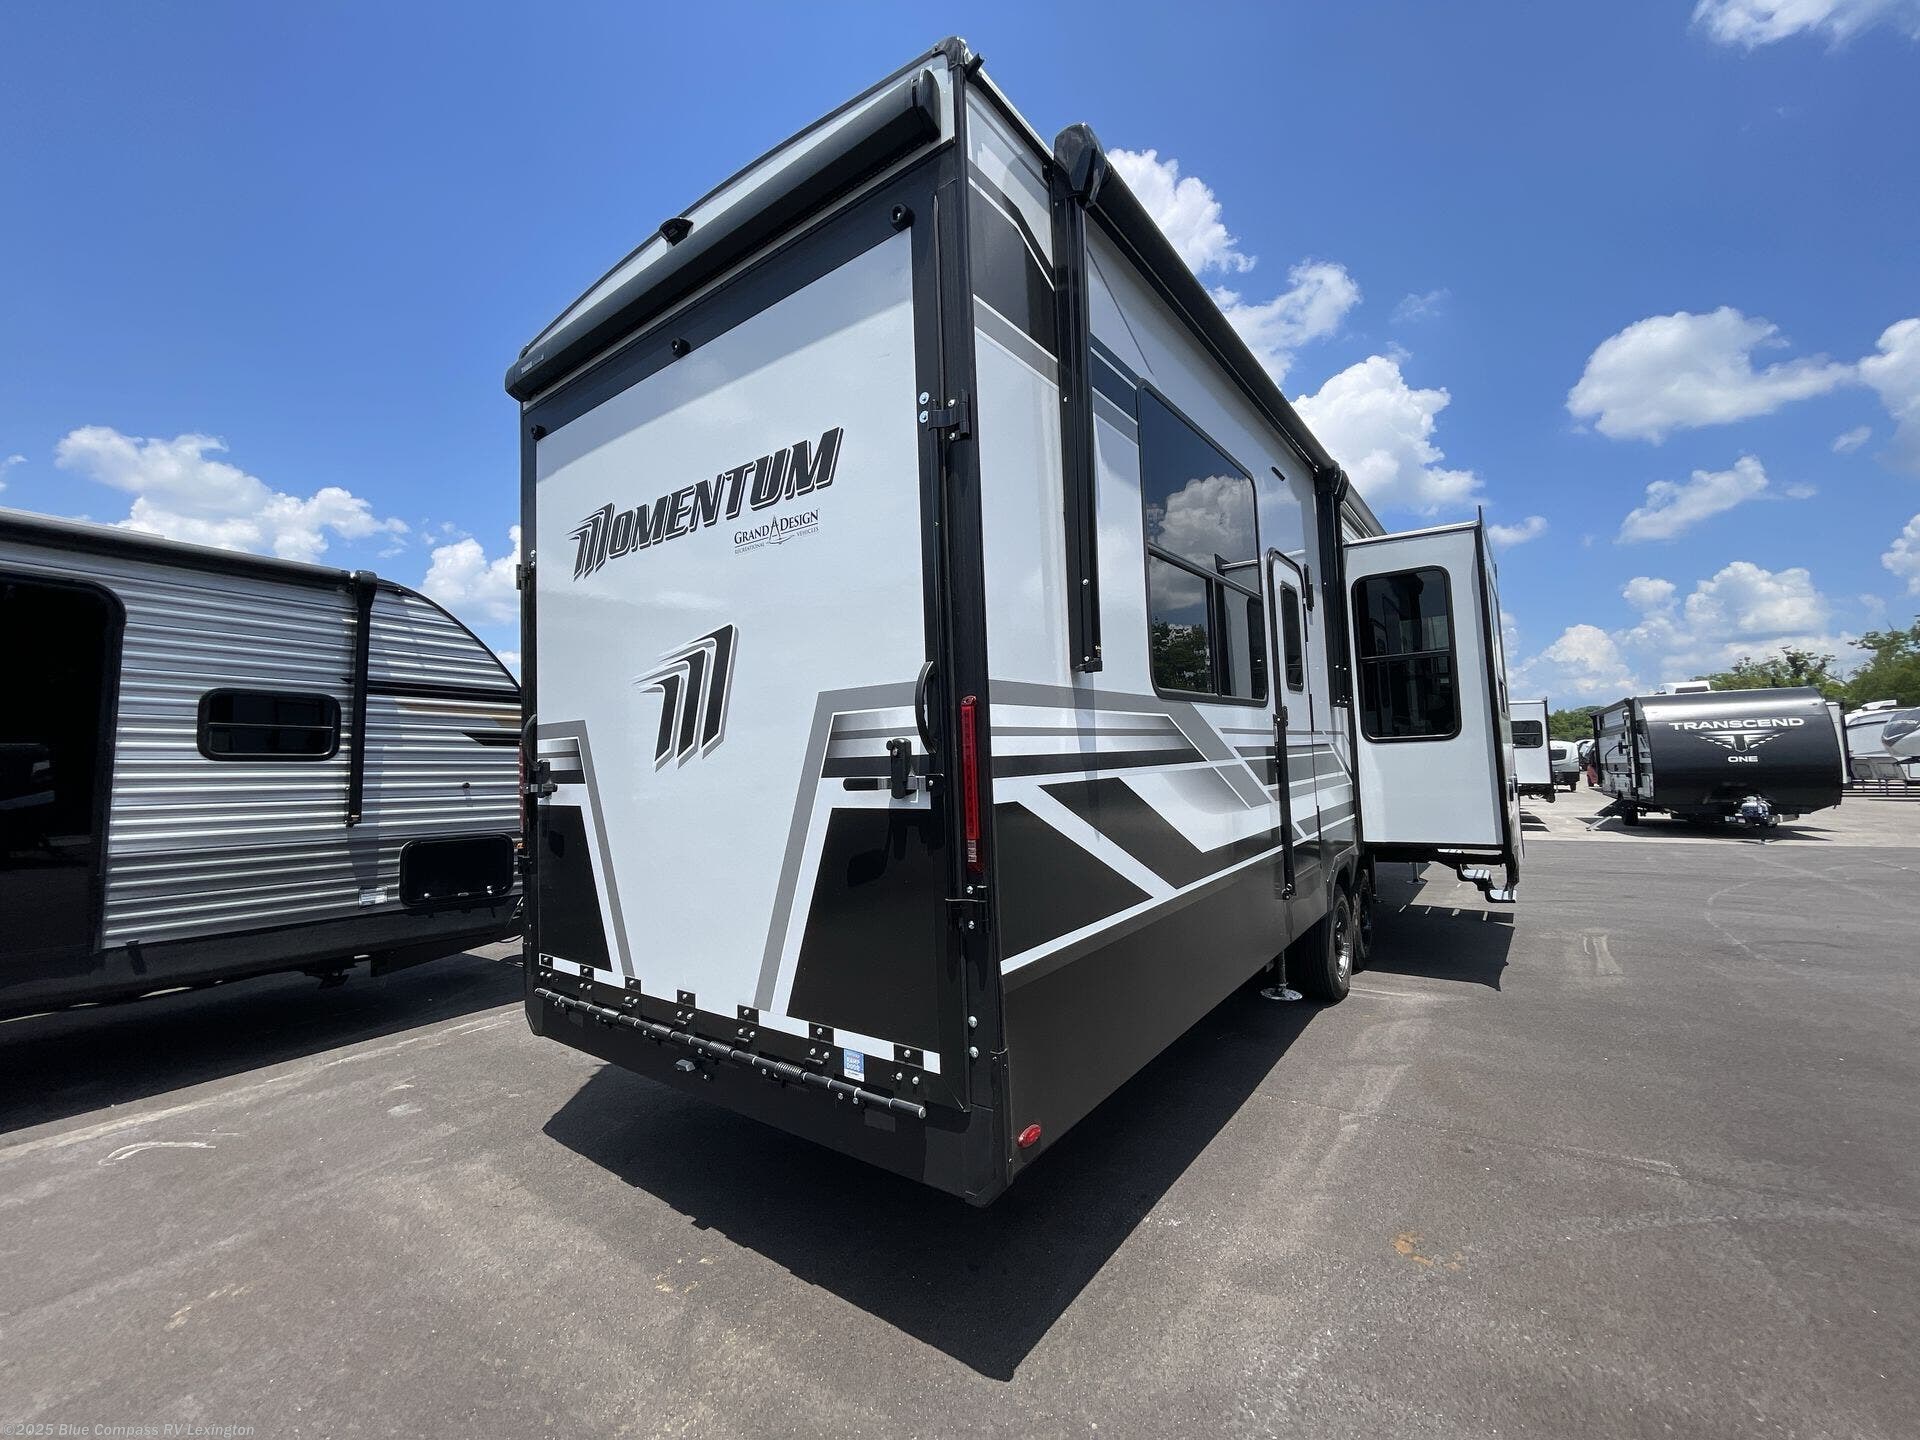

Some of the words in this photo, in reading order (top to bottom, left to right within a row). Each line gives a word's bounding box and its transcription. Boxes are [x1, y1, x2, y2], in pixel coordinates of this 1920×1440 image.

[565, 427, 844, 582] MOMENTUM
[734, 525, 770, 545] GRAND
[780, 509, 819, 532] DESIGN
[1668, 717, 1805, 731] TRANSCEND
[1727, 755, 1759, 763] ONE
